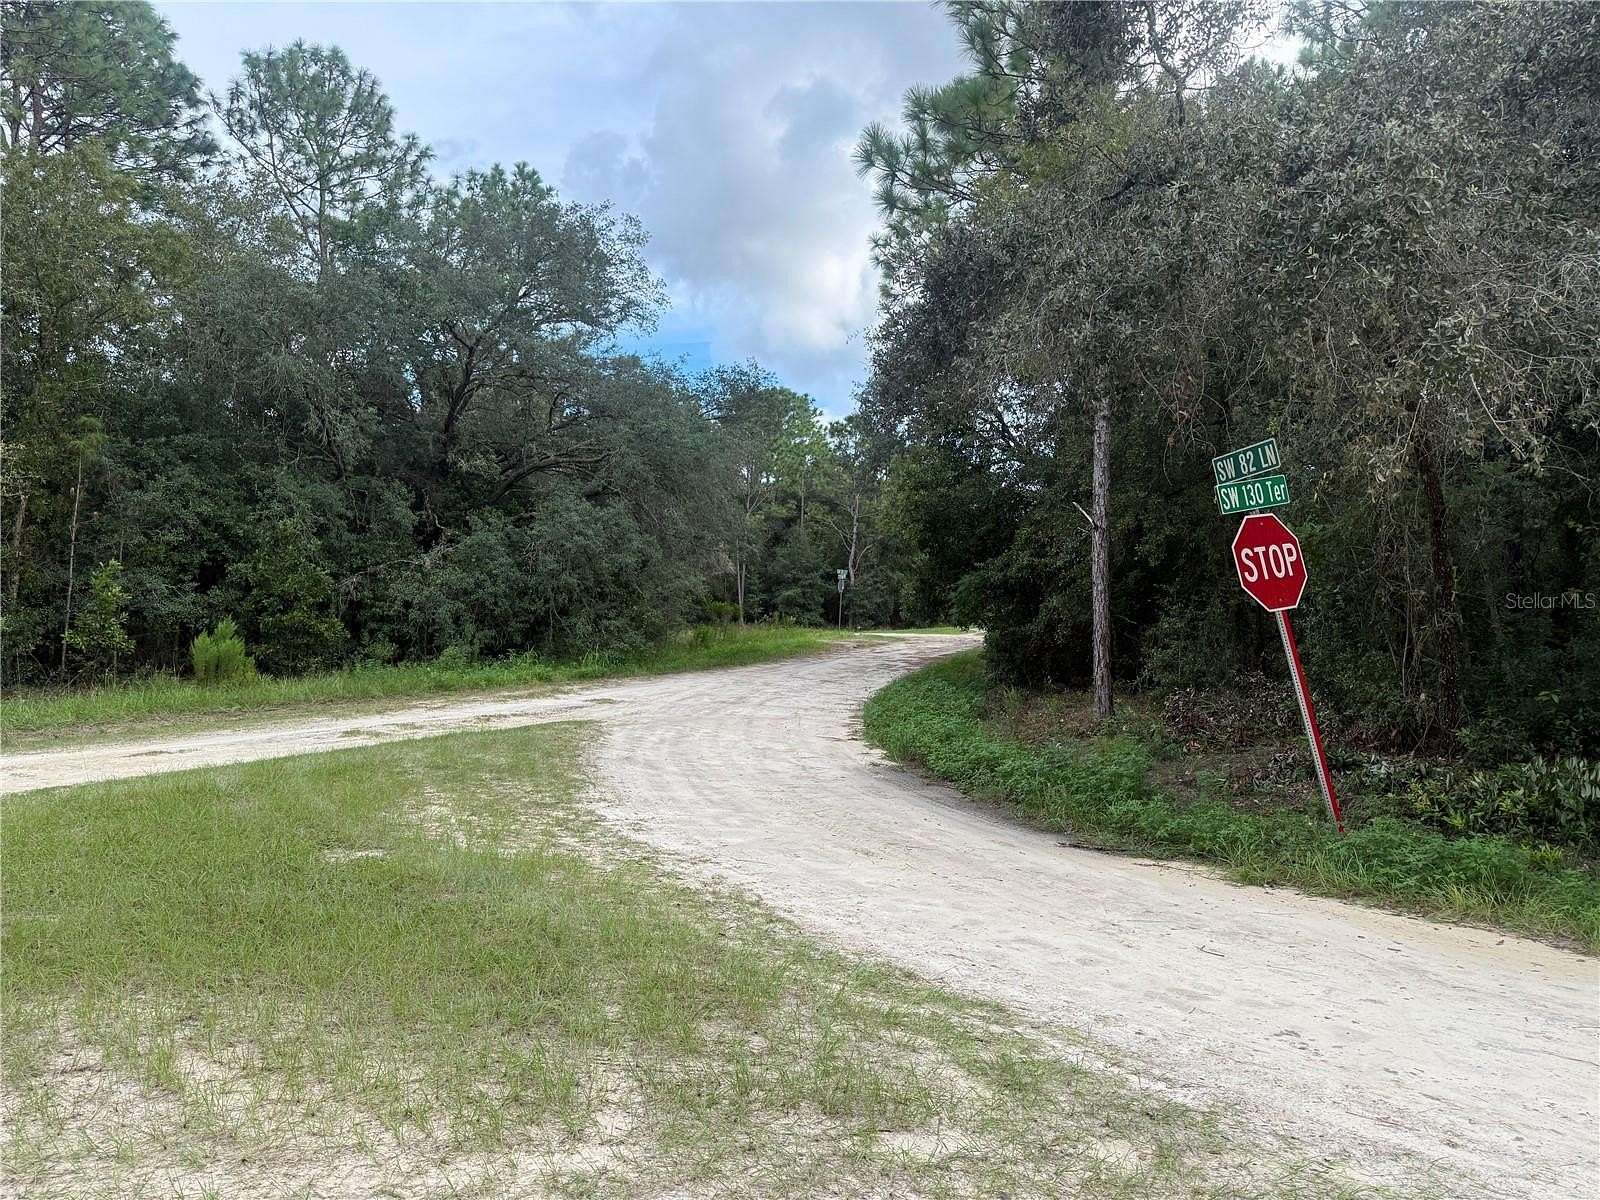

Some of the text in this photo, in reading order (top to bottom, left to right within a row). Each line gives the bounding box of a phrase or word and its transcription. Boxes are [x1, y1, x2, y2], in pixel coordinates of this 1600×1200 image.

[1216, 444, 1277, 481] SW 82 LN
[1220, 481, 1286, 510] SW 130 Ter
[1240, 543, 1297, 582] STOP
